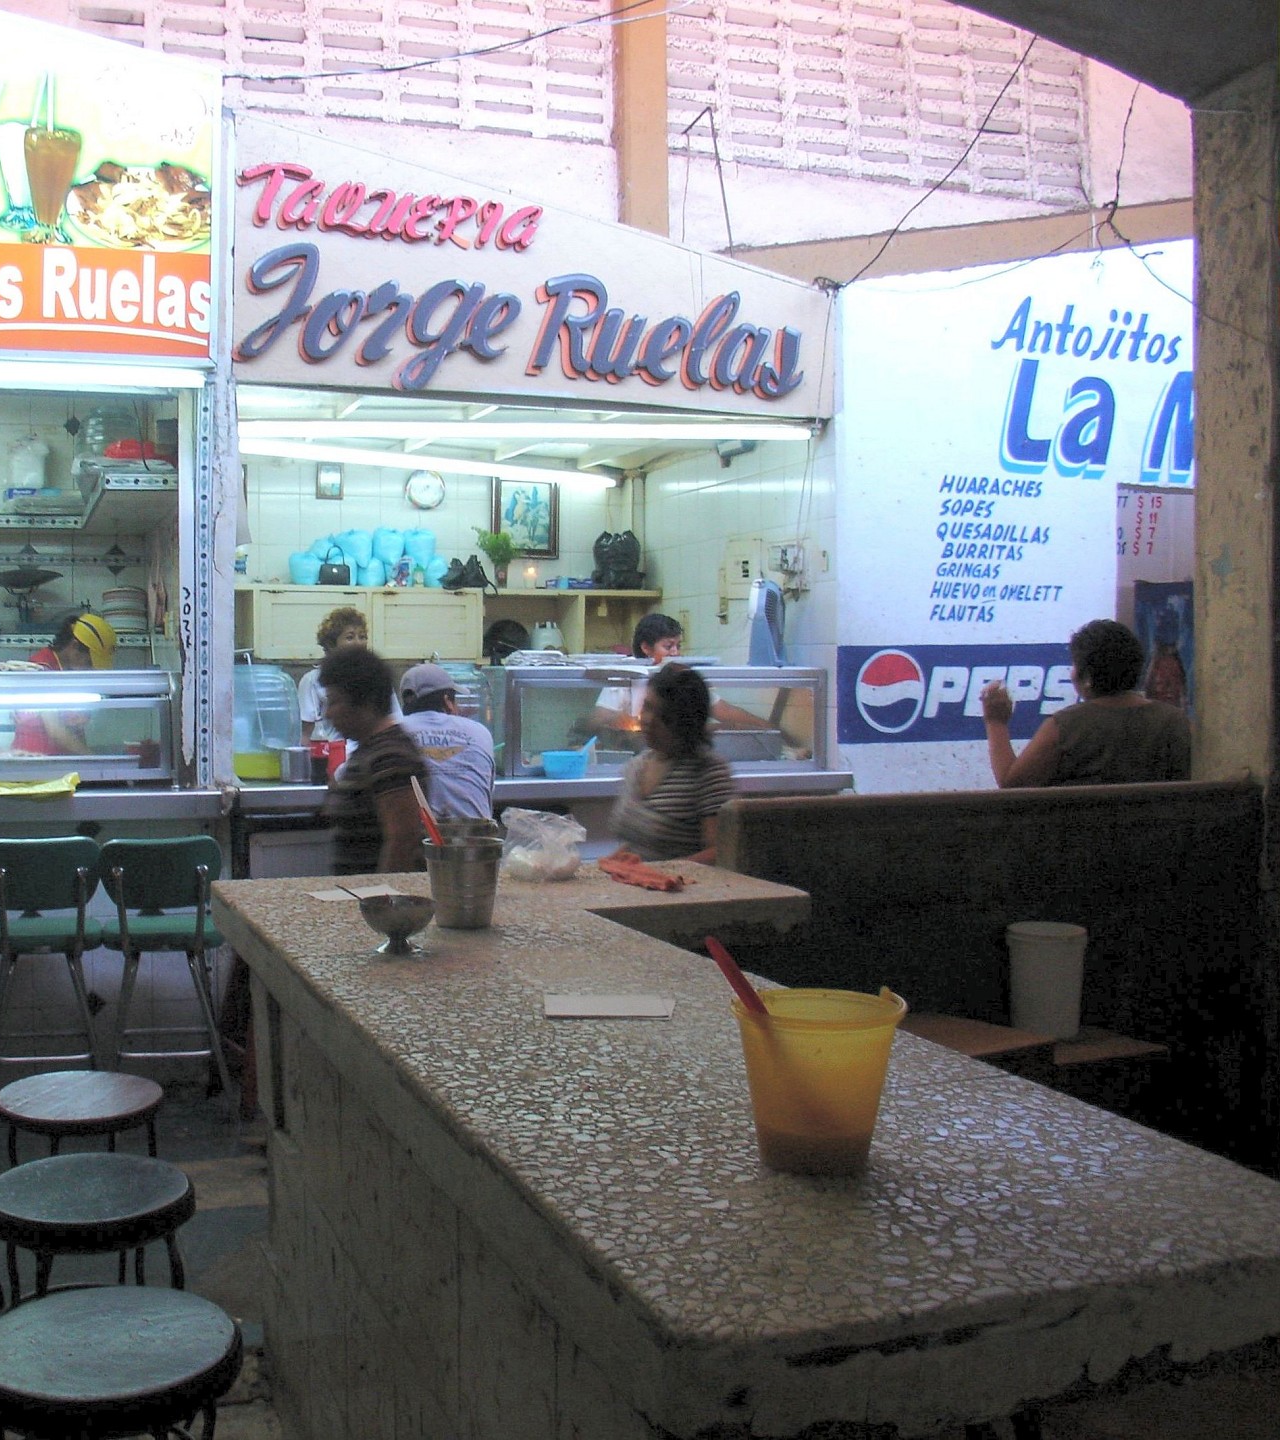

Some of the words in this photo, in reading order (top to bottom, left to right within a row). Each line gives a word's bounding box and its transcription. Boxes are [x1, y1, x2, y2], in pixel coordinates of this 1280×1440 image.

[42, 246, 210, 331] Ruelas
[232, 241, 522, 391] Jorge
[524, 273, 804, 399] Ruelas
[991, 295, 1182, 364] Antojitos
[998, 359, 1116, 480] La
[939, 474, 1042, 498] HUARACHES
[939, 499, 993, 519] SOPES
[936, 522, 1050, 545] QUESADILLAS
[940, 542, 1023, 561] BURRITAS
[936, 561, 1000, 580] GRINGAS
[930, 581, 980, 601] HUEVO
[999, 584, 1062, 602] OMELETT
[929, 602, 995, 623] FLAUTAS
[922, 665, 1084, 718] PEPS
